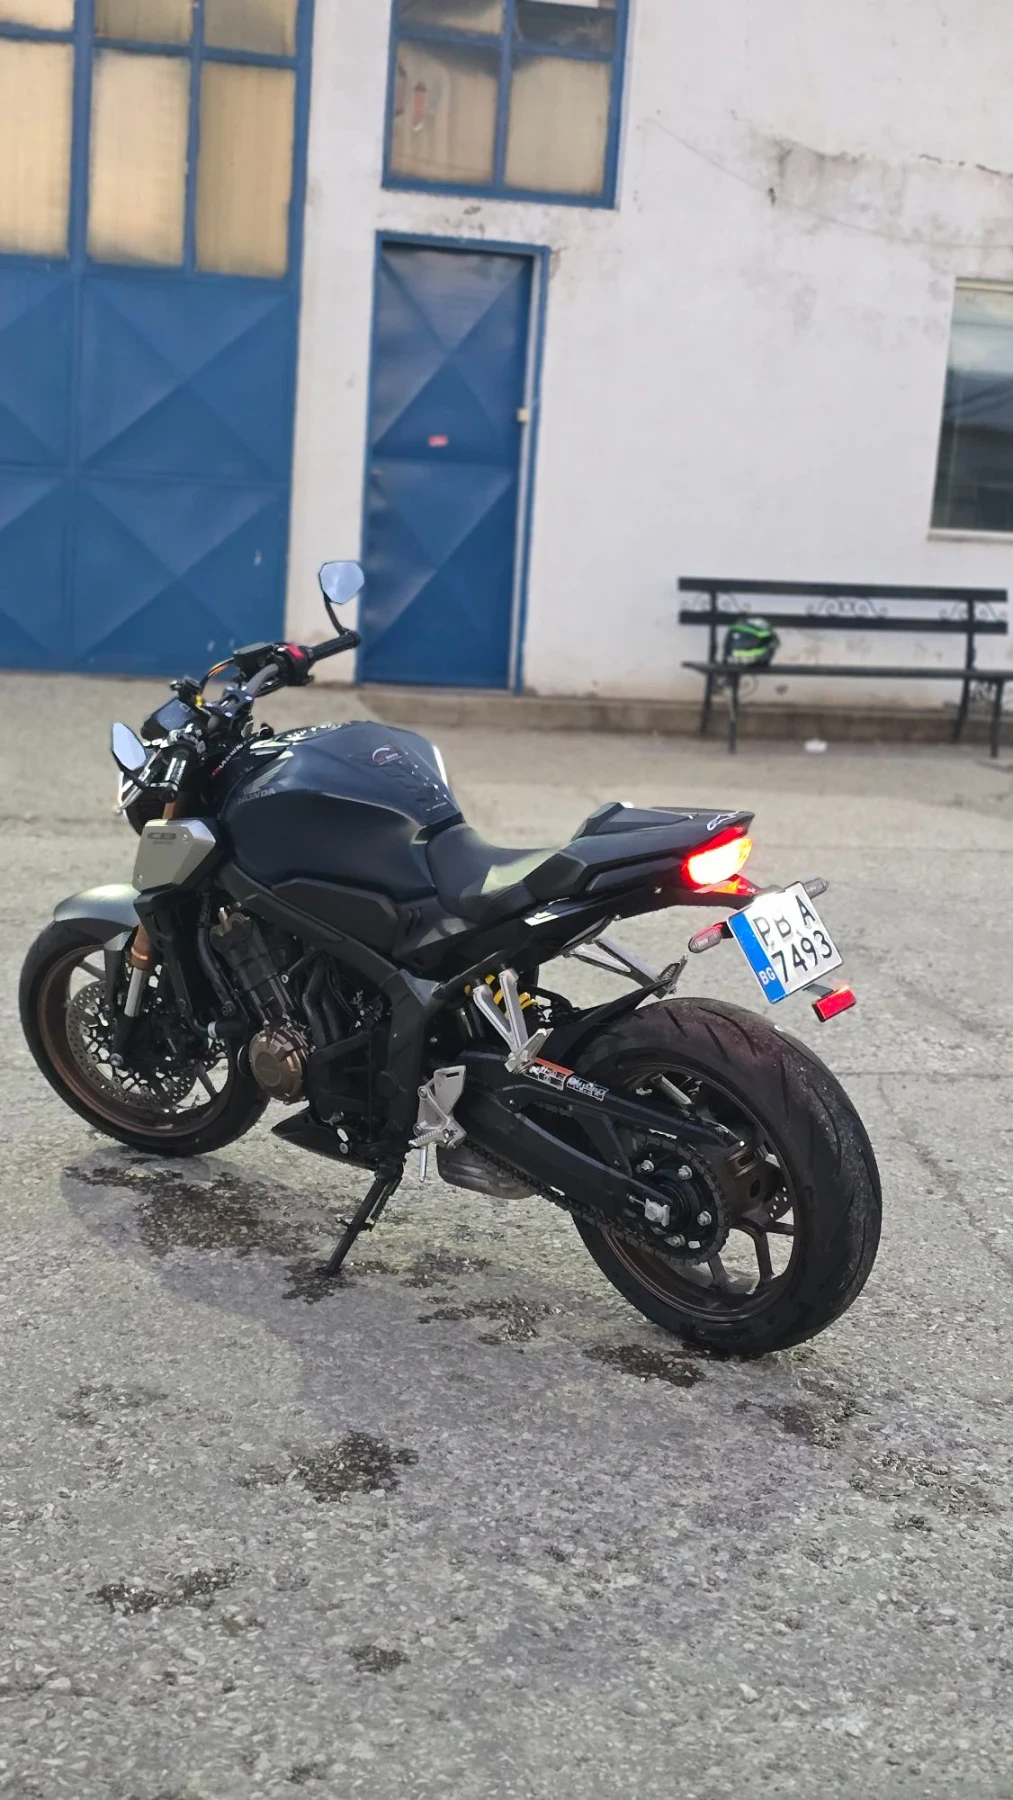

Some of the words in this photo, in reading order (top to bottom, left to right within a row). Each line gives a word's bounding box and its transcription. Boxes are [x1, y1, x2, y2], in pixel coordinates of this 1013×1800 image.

[238, 788, 276, 804] HONDA
[795, 895, 816, 927] A
[771, 930, 832, 983] 7493
[758, 967, 776, 985] BG
